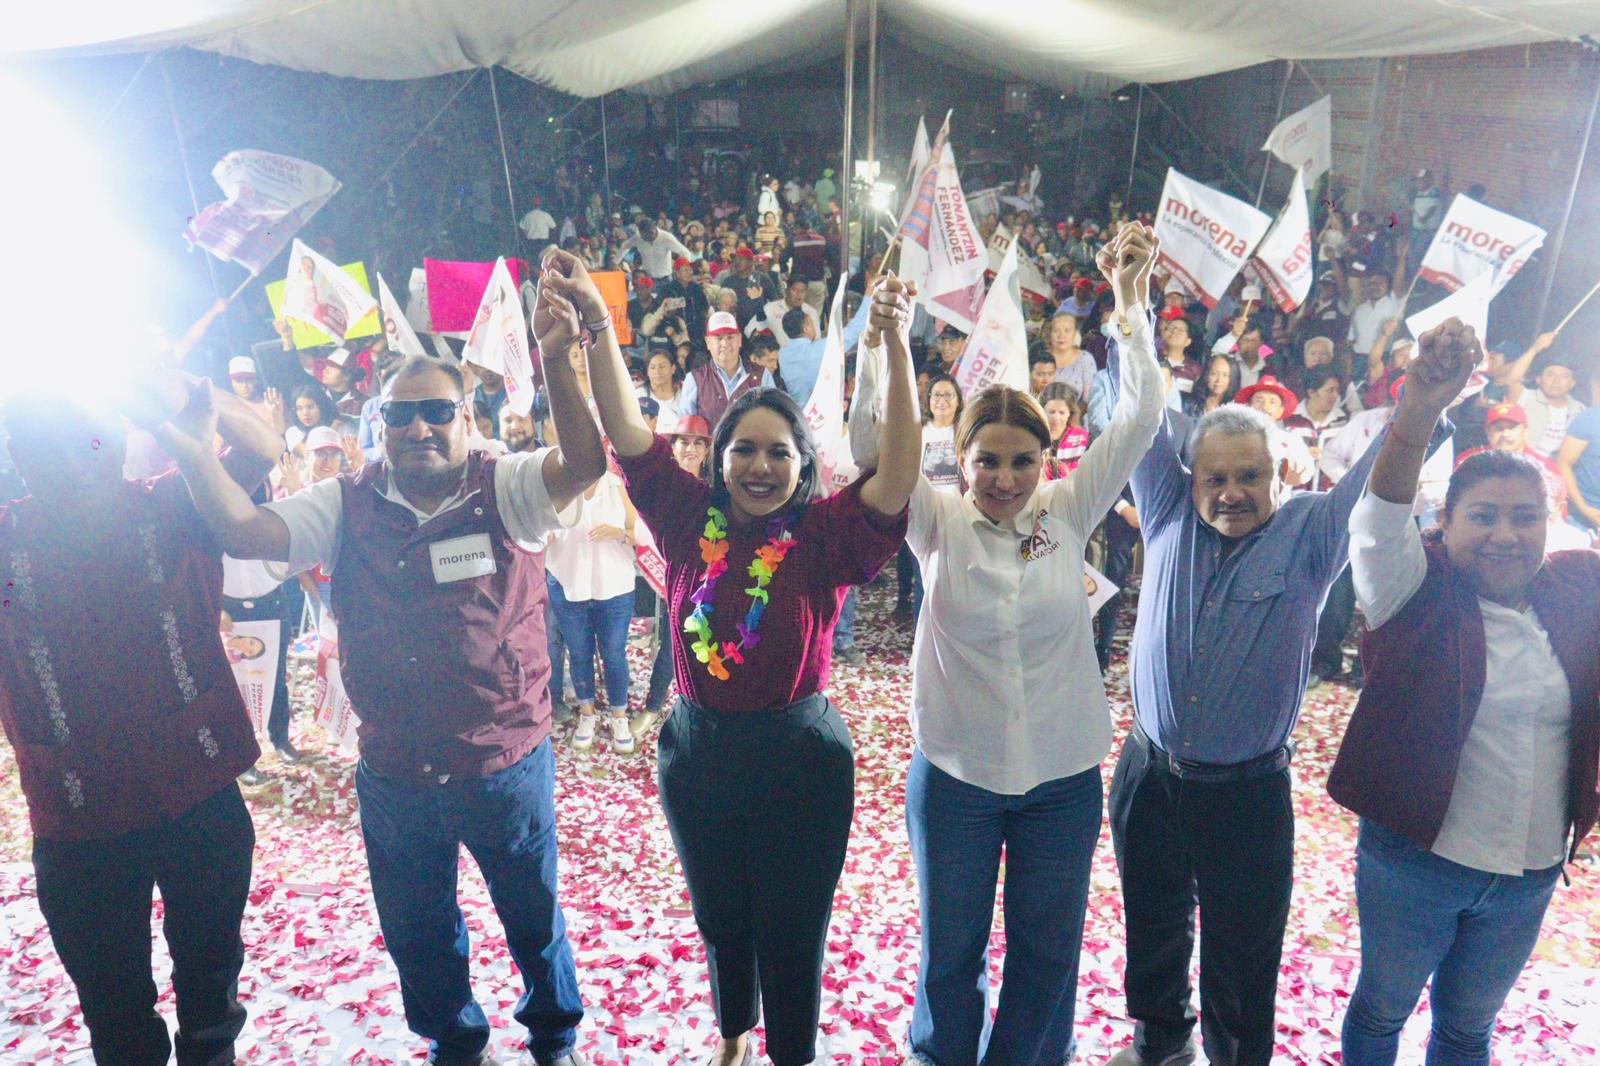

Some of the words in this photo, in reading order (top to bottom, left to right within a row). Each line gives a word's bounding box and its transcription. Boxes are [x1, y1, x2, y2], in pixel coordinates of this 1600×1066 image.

[950, 184, 978, 260] TONANTZIN
[1166, 197, 1248, 258] morena
[439, 551, 486, 566] morena
